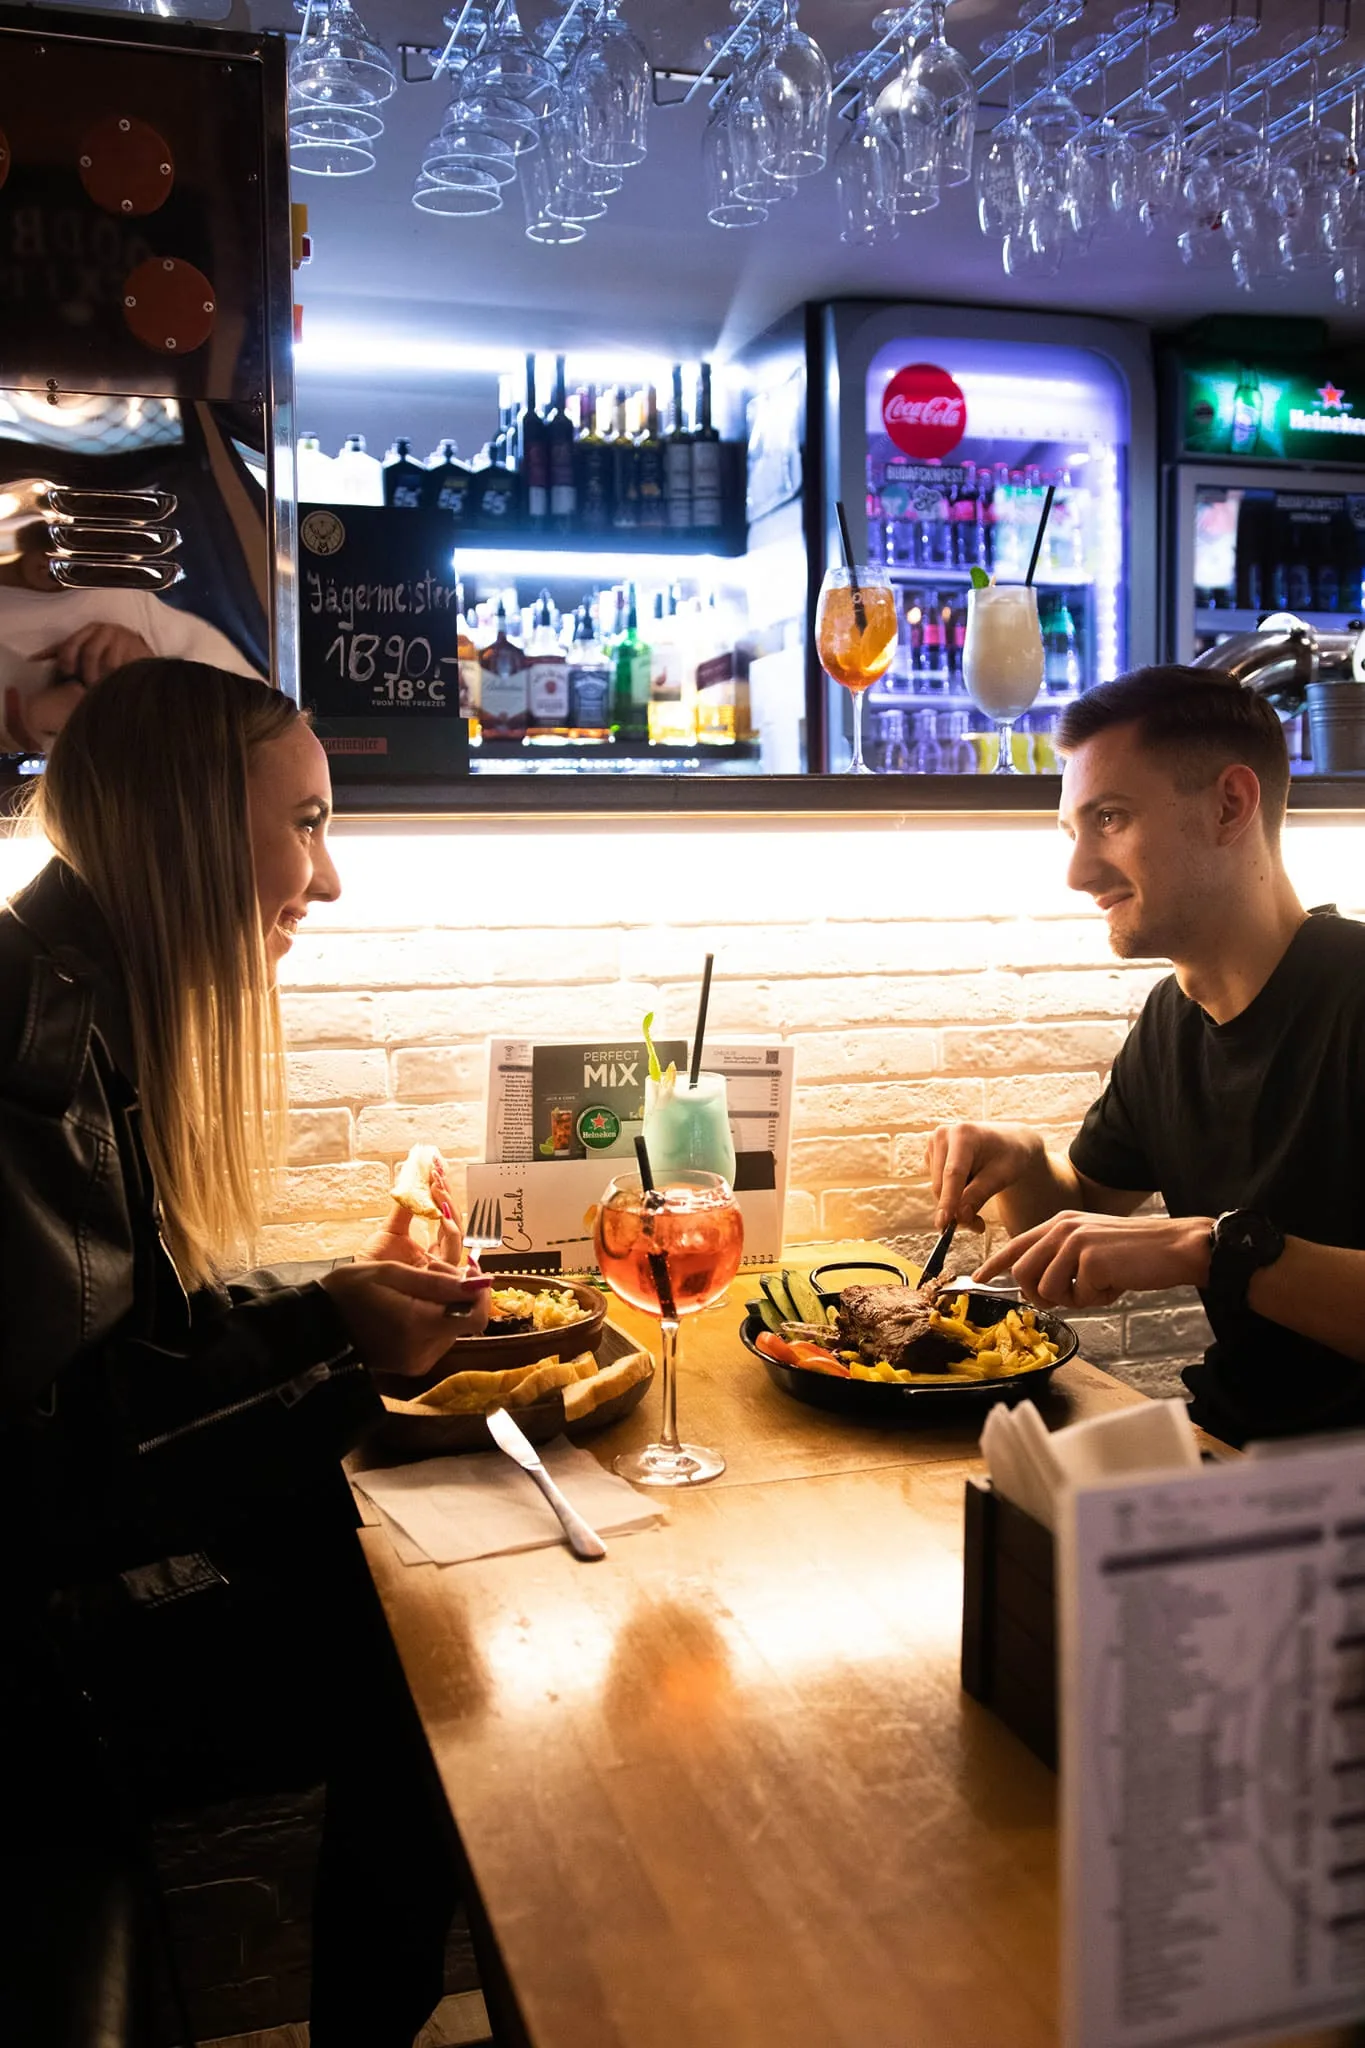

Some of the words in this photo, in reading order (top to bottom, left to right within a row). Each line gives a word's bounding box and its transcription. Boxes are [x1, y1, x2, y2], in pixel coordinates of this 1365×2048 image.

[306, 569, 456, 631] Jägermeister
[583, 1050, 640, 1062] PERFECT
[583, 1062, 639, 1089] MIX
[582, 1131, 617, 1139] Heineken
[502, 1187, 533, 1252] Cocktails
